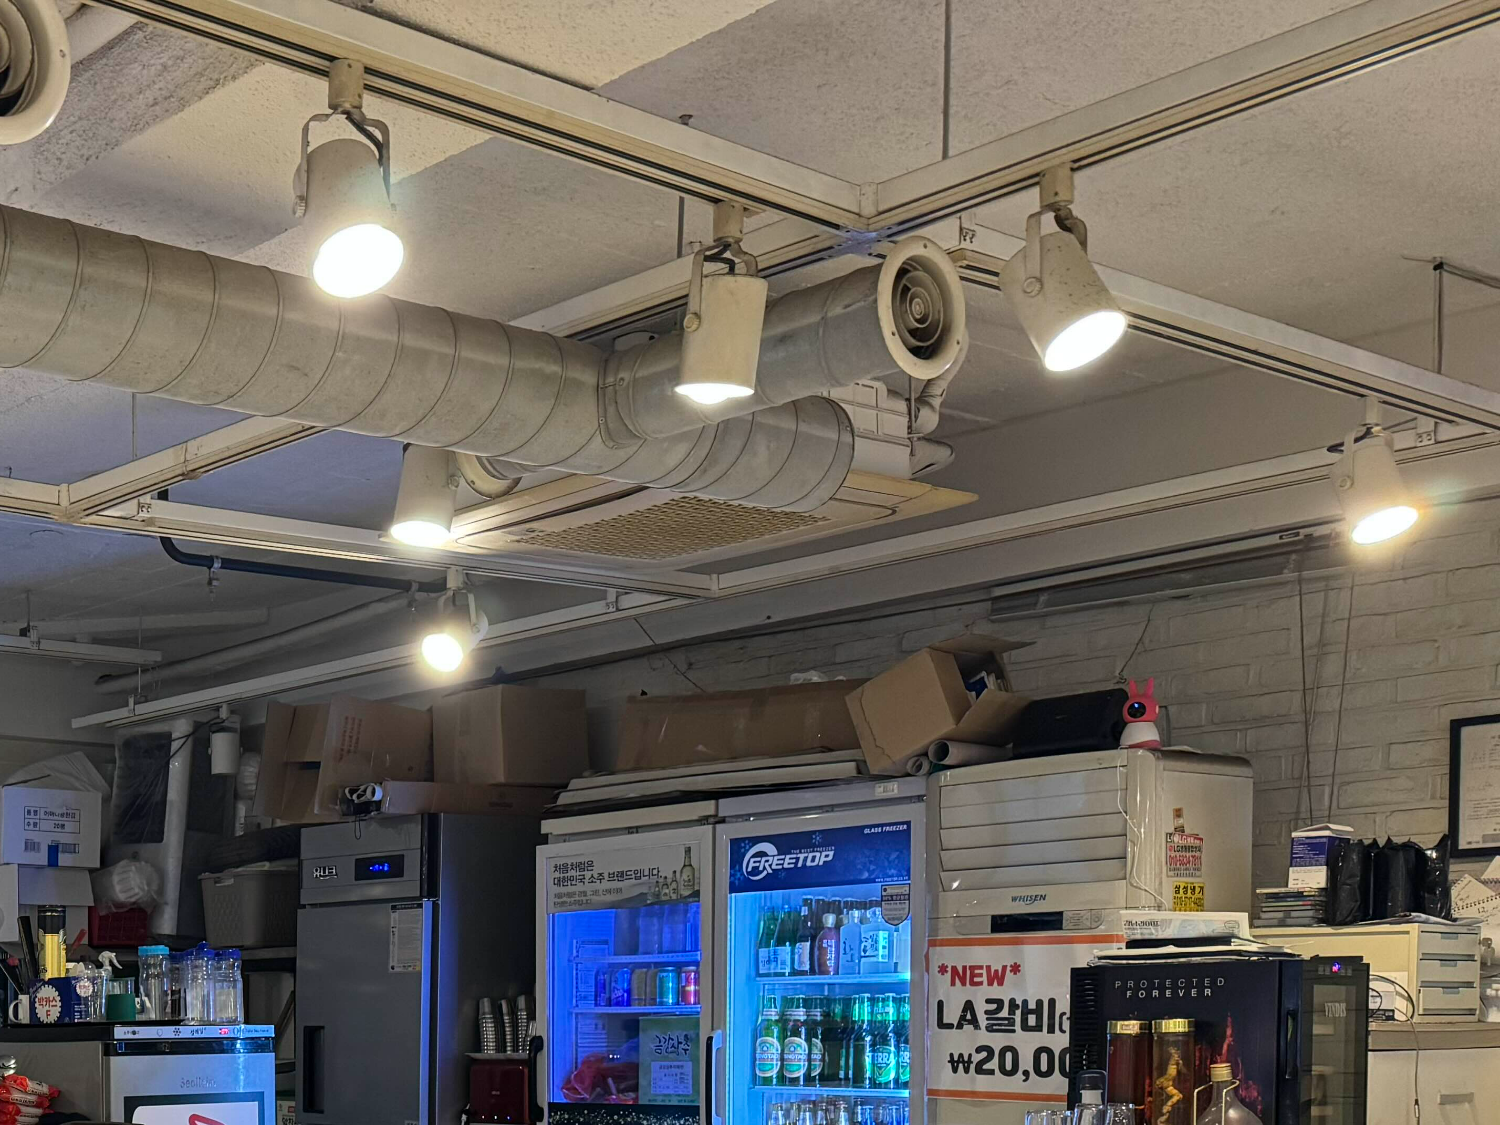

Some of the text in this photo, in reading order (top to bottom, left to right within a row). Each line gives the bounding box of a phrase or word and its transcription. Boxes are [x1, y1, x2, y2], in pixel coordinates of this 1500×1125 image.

[863, 824, 908, 835] GLASS FREEZER
[553, 860, 595, 875] 처음처럼은
[747, 850, 835, 874] FREETOP
[553, 867, 663, 888] 대한민국 소주 브랜드입니다.
[1011, 893, 1047, 905] WHISEN
[1115, 977, 1225, 989] PROTECTED
[1126, 988, 1212, 999] FOREVER
[37, 996, 59, 1009] 박카스
[45, 1010, 51, 1020] F
